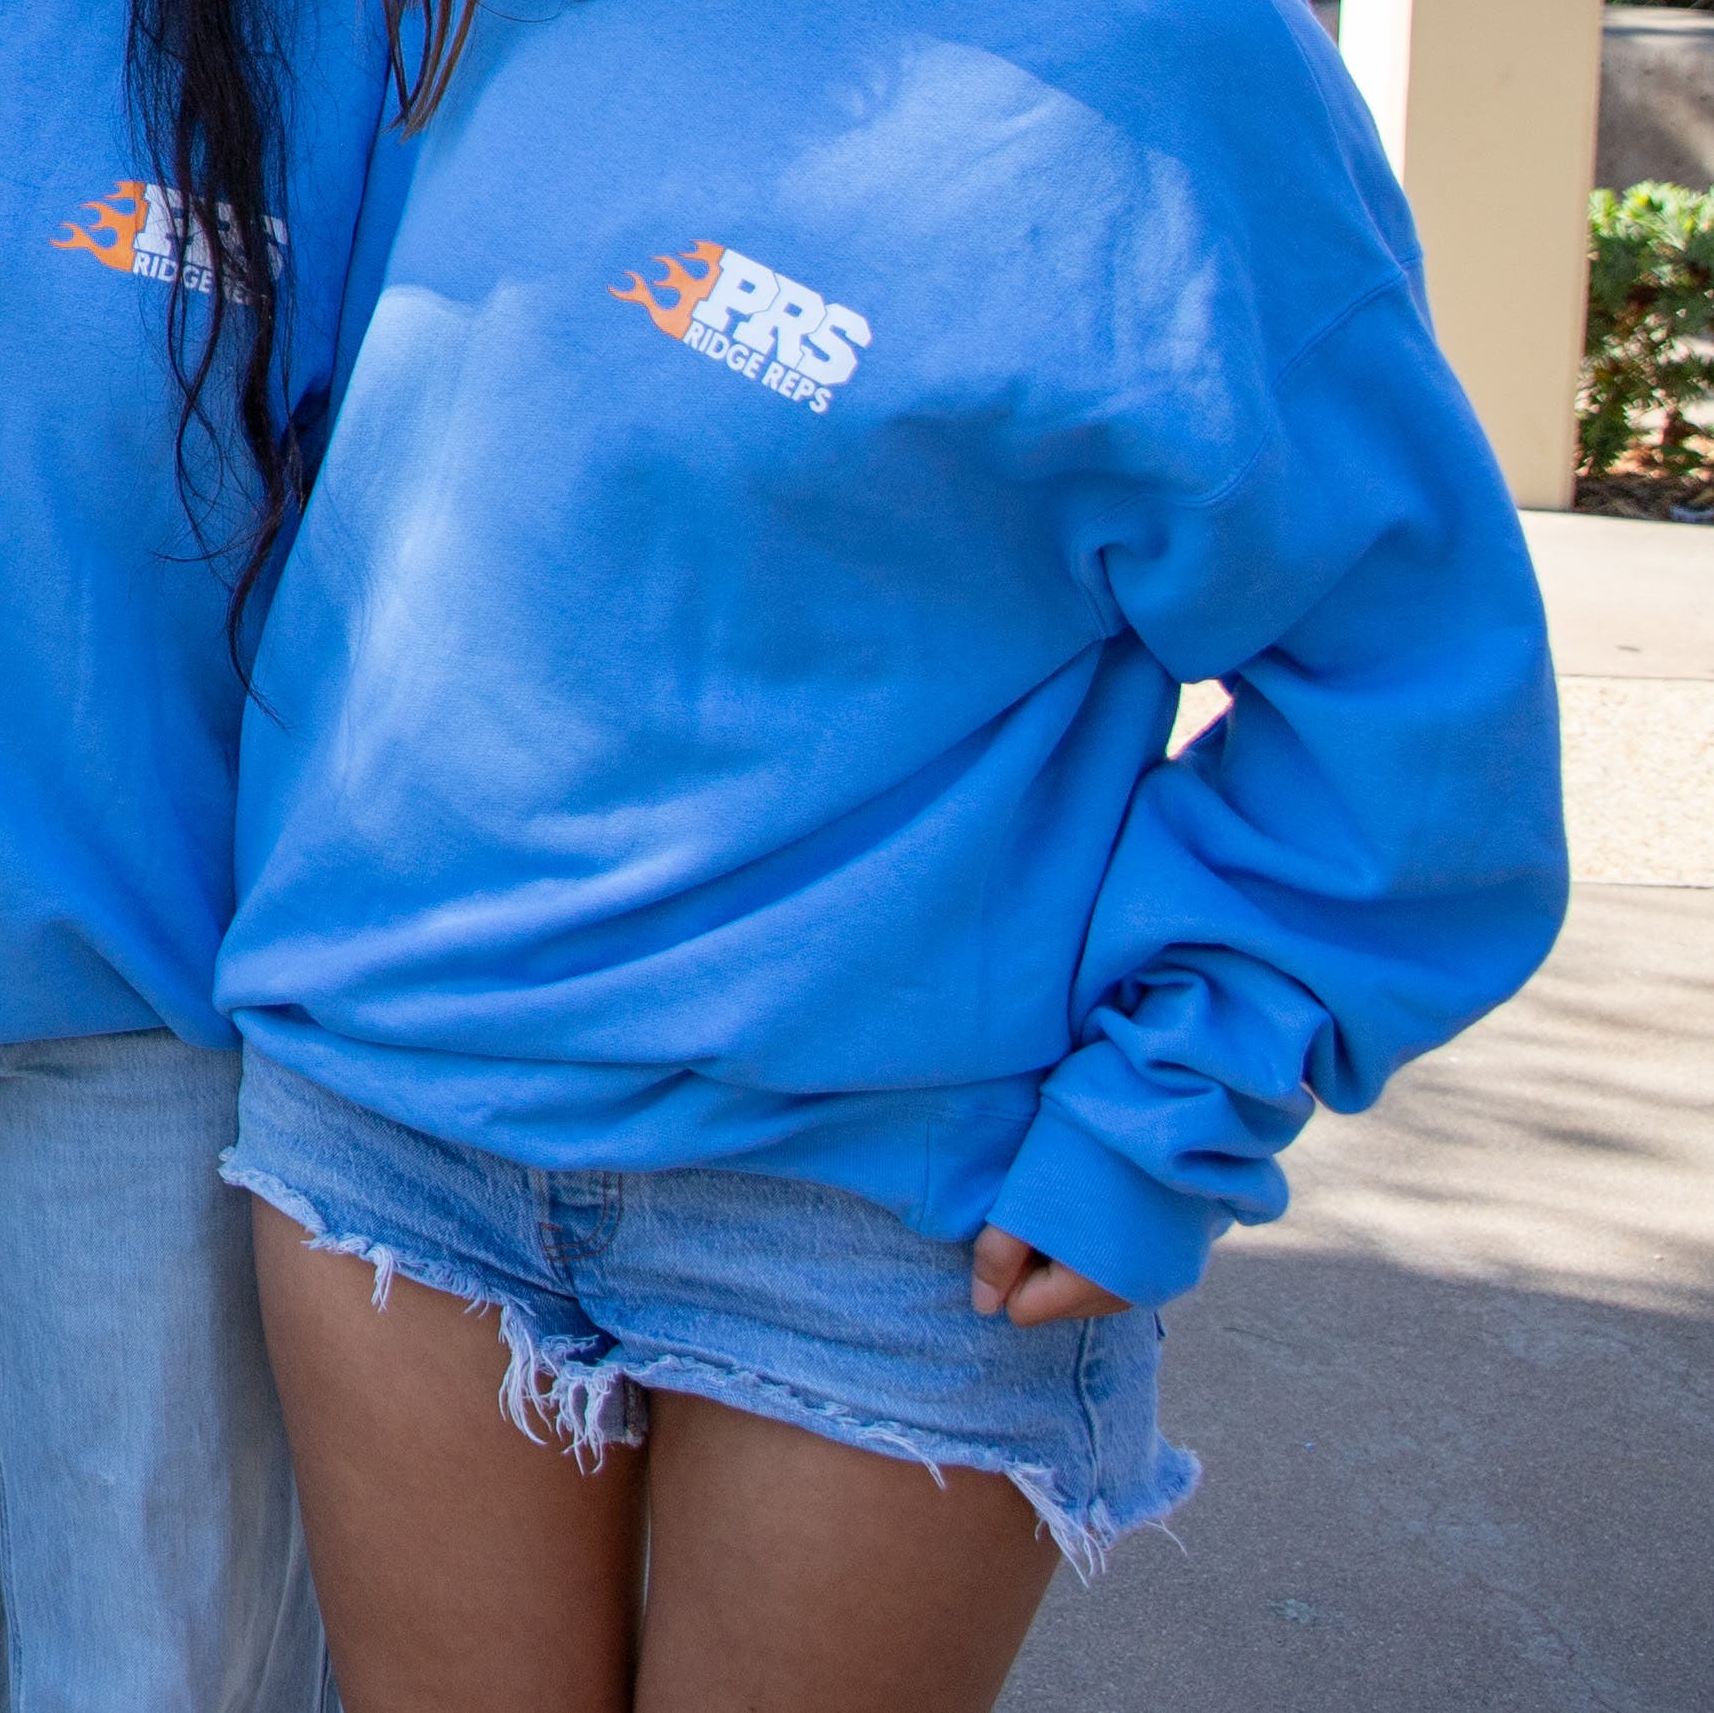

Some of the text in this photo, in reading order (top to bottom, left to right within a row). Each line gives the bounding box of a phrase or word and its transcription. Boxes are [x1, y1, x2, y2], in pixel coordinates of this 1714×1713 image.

[133, 251, 213, 293] RIDGE
[691, 248, 872, 386] PRS
[683, 320, 832, 414] RIDGE REPS
